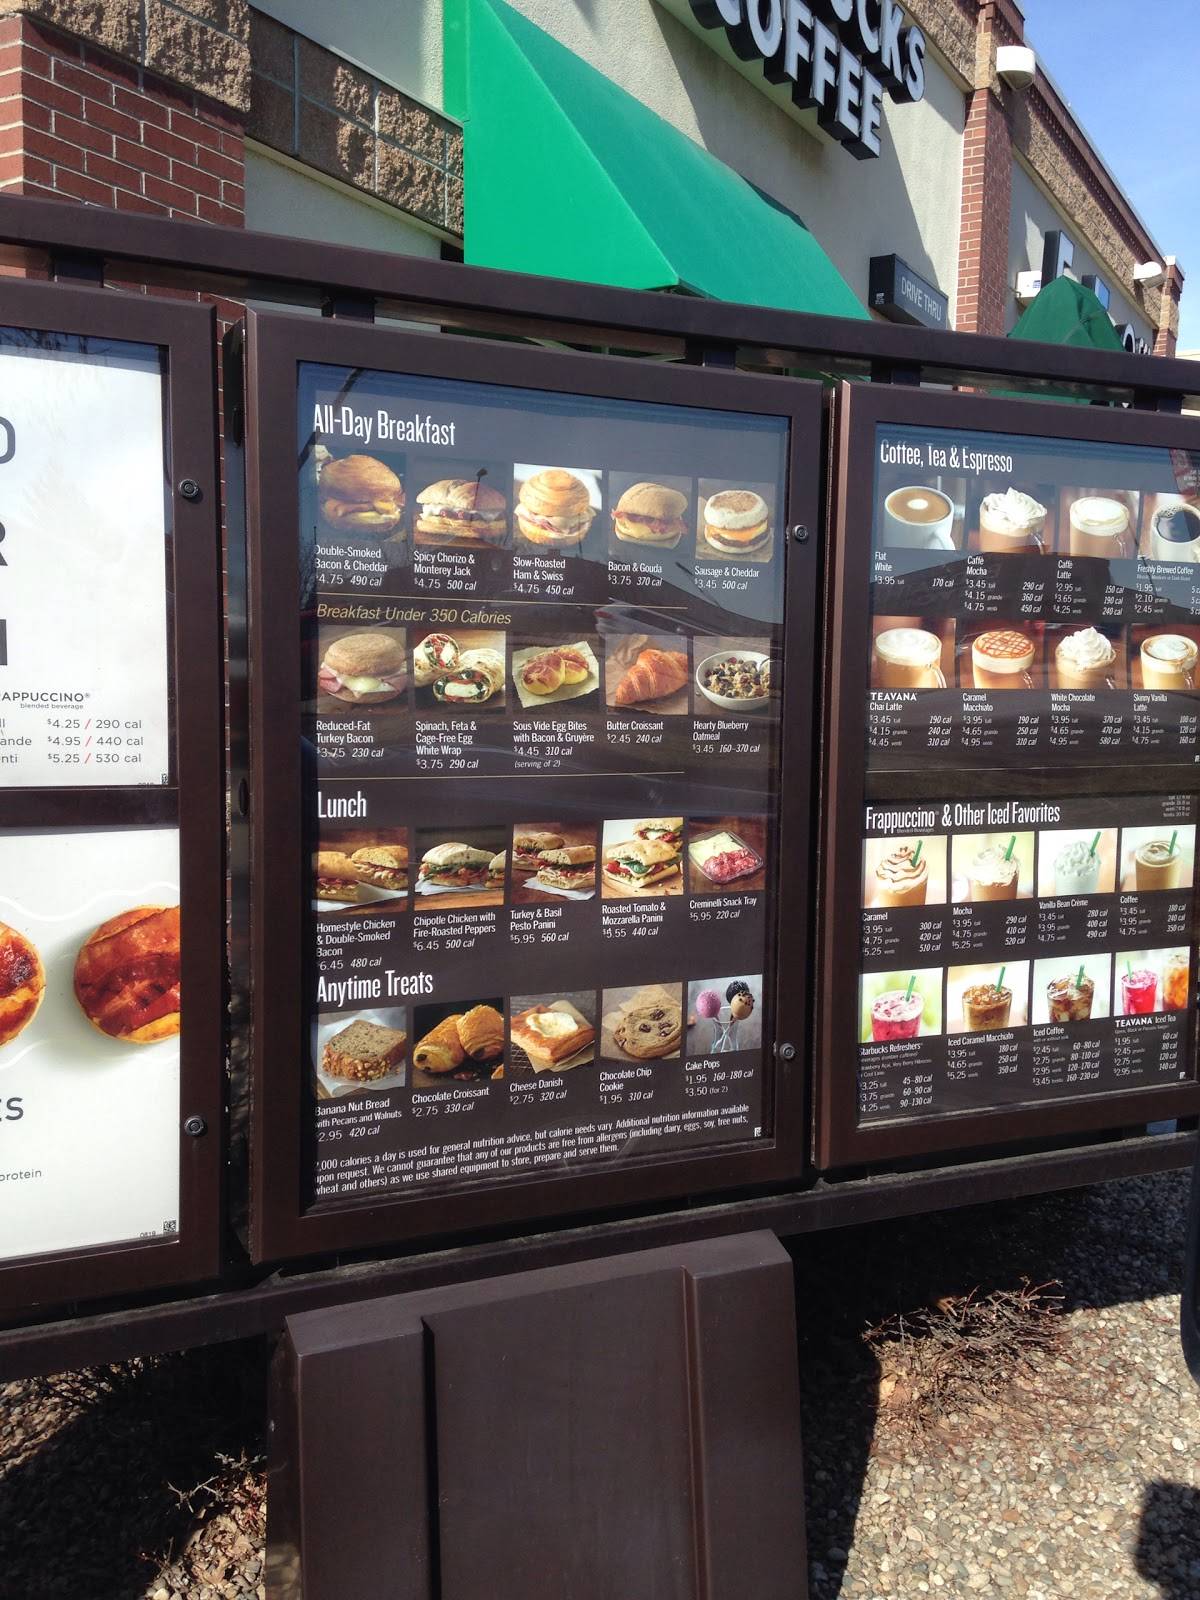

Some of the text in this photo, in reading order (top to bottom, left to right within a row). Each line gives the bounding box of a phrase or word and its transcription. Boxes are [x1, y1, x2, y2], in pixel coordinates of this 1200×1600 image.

[717, 0, 883, 158] OFFEE
[901, 276, 923, 308] DRIVE
[924, 293, 942, 321] THRU
[313, 404, 456, 446] All-Day Breakfast
[880, 440, 1013, 475] Coffee, Tea & Espresso
[414, 551, 475, 564] Spicy Chorizo &
[875, 552, 886, 561] Flat
[343, 559, 351, 570] &
[352, 559, 388, 573] Cheddar
[513, 557, 566, 569] Slow-Roasted
[608, 561, 663, 574] Bacon & Gouda
[875, 562, 893, 572] White
[414, 563, 471, 577] Monterey Jack
[513, 569, 564, 582] Ham & Swiss
[694, 566, 760, 578] Sausage & Cheddar
[966, 566, 987, 576] Mocha
[414, 577, 477, 591] $4.75 500 cal
[608, 575, 663, 587] $3.75 370 cal
[317, 604, 512, 625] Breakfast Under 350 Calories
[870, 692, 917, 701] TEAVANA
[962, 693, 987, 701] Caramel
[1051, 693, 1096, 702] White Chocolate
[869, 702, 903, 711] Chai Latte
[963, 703, 993, 712] Macchiato
[1051, 703, 1071, 712] Mocha
[47, 718, 142, 729] $4.25 290 cal
[316, 721, 371, 731] Reduced-Fat
[415, 721, 477, 732] Spinach, Feta &
[513, 721, 587, 733] Sous Vide Egg Bites
[606, 721, 664, 731] Butter Croissant
[693, 720, 749, 731] Hearty Blueberry
[47, 735, 144, 746] $4.95 440 cal
[316, 733, 374, 745] Turkey Bacon
[416, 733, 473, 745] Cage-Free Egg
[513, 733, 530, 742] with
[531, 733, 556, 742] Bacon
[557, 733, 564, 742] &
[693, 732, 720, 741] Oatmeal
[416, 745, 461, 757] White Wrap
[47, 753, 142, 763] $5.25 530 cal
[416, 758, 479, 769] $3.75 290 cal
[317, 791, 367, 818] Lunch
[941, 803, 952, 827] &
[954, 803, 985, 827] Other
[987, 802, 1009, 825] Iced
[1012, 801, 1060, 824] Favorites
[723, 897, 742, 907] Snack
[743, 896, 757, 906] Tray
[1120, 895, 1138, 904] Coffee
[602, 901, 666, 914] Roasted Tomato &
[953, 907, 973, 916] Mocha
[413, 912, 496, 927] Chipotle Chicken with
[510, 907, 562, 921] Turkey & Basil
[602, 914, 663, 926] Mozzarella Panini
[316, 919, 396, 933] Homestyle Chicken
[413, 924, 496, 938] Fire-Roasted Peppers
[510, 919, 556, 931] Pesto Panini
[325, 931, 391, 944] Double-Smoked
[510, 931, 569, 944] $5.95 560 cal
[316, 970, 434, 1008] Anytime Treats
[1115, 1018, 1153, 1028] TEAVANA
[1033, 1027, 1065, 1037] Iced Coffee
[948, 1032, 1014, 1046] Iced Caramel Macchiato
[685, 1060, 720, 1072] Cake Pops
[600, 1067, 652, 1082] Chocolate Chip
[510, 1078, 564, 1093] Cheese Danish
[600, 1081, 624, 1092] Cookie
[411, 1087, 490, 1105] Chocolate Croissant
[348, 1101, 364, 1113] Nut
[365, 1098, 390, 1110] Bread
[411, 1102, 475, 1117] $2.75 330 cal
[331, 1110, 402, 1127] Pecans and Walnuts
[340, 1136, 504, 1168] calories a day is used for general nutrition
